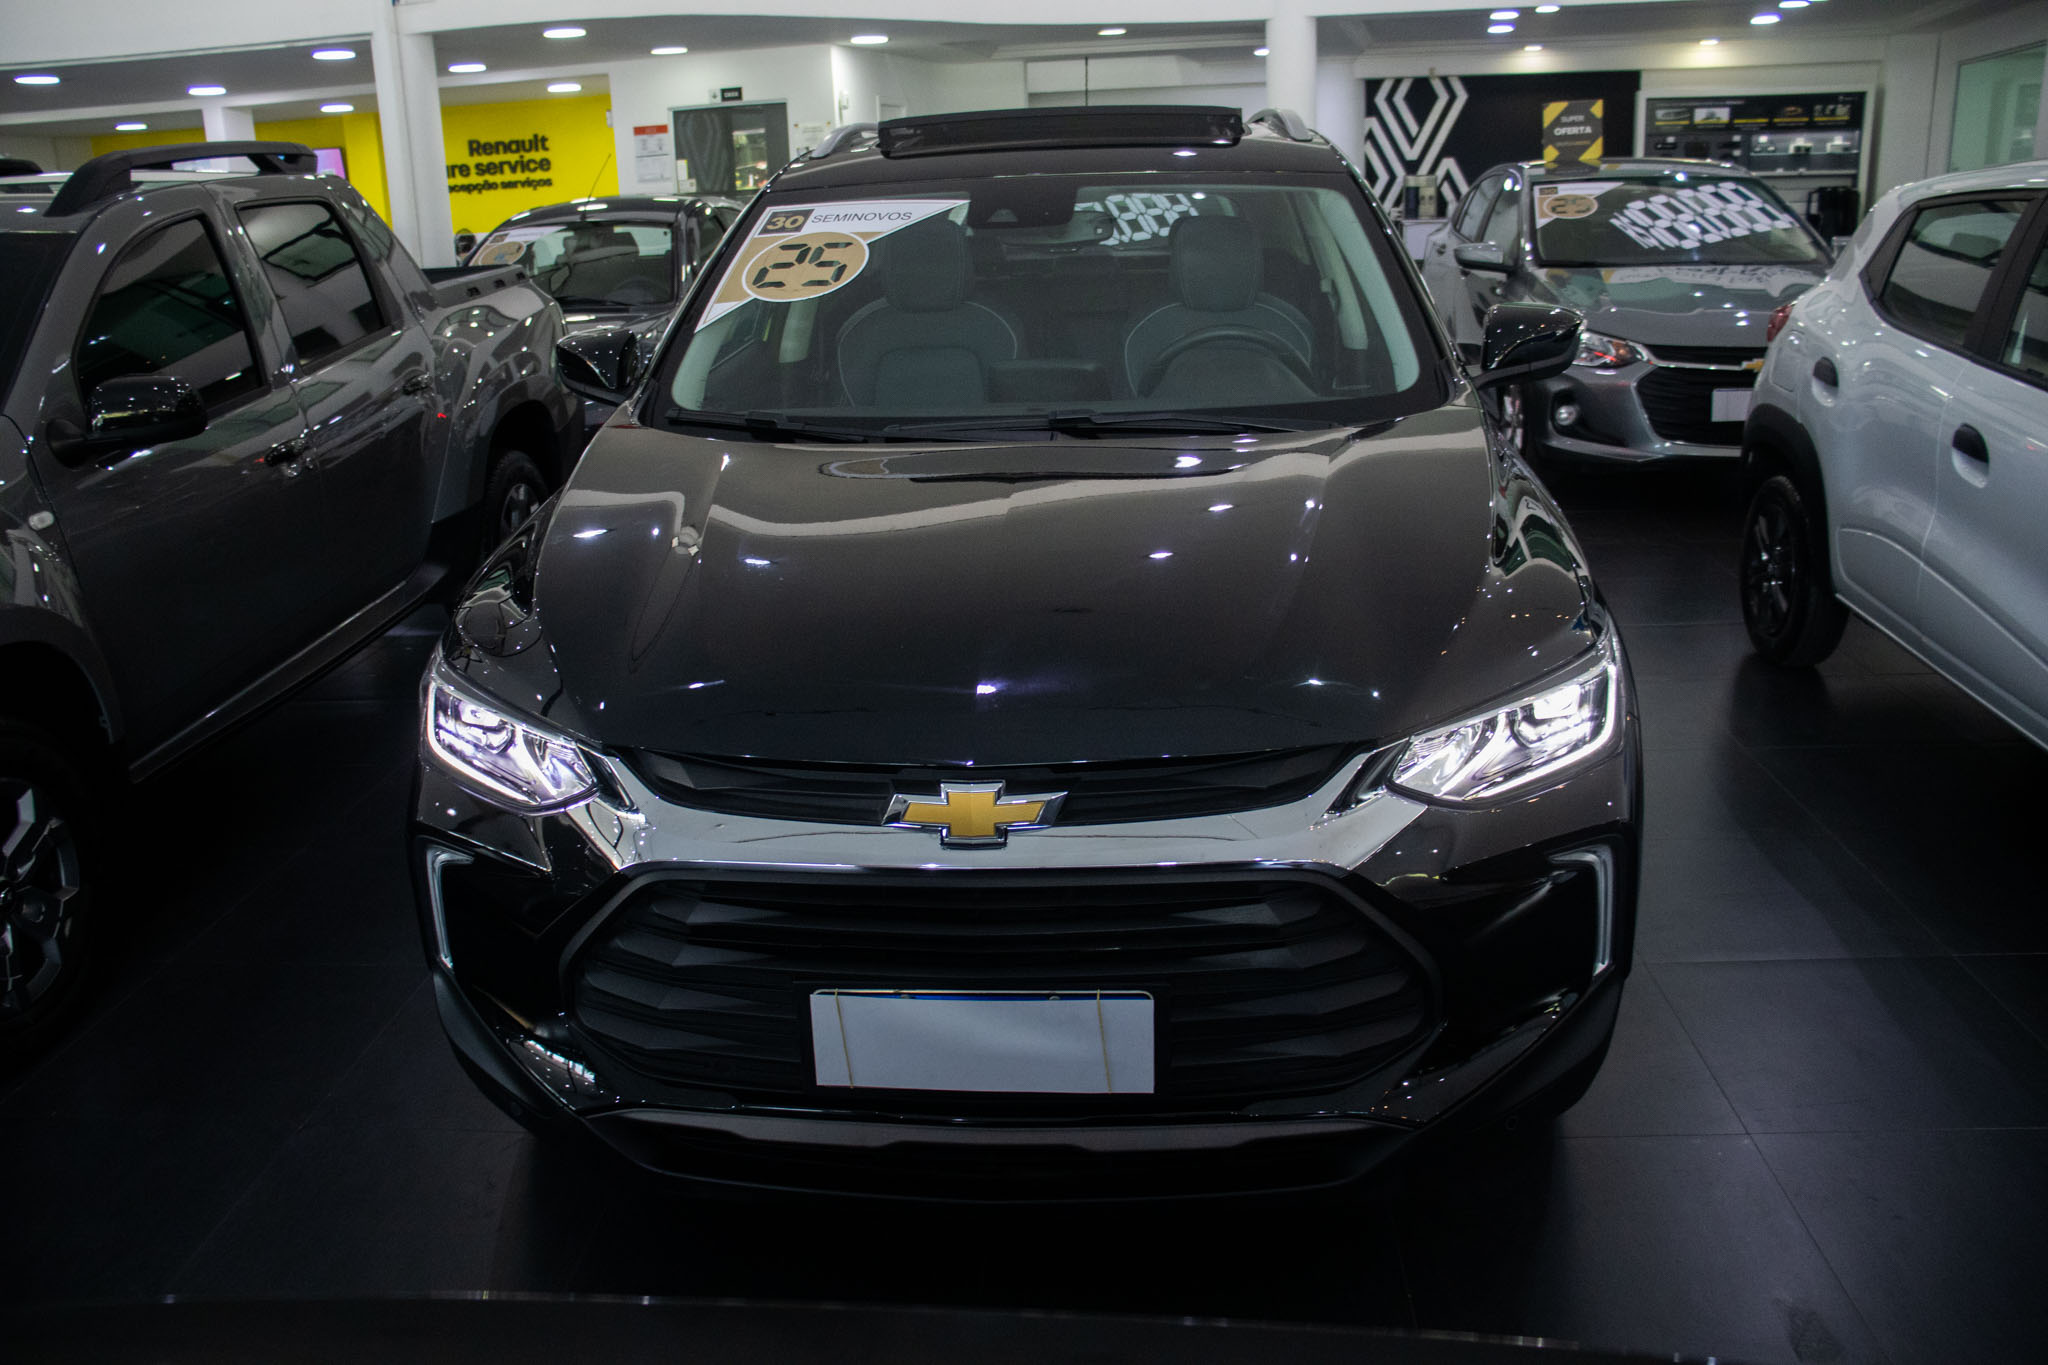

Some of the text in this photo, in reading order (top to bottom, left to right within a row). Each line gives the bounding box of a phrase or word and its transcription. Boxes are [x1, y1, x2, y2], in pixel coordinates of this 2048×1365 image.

[1553, 126, 1593, 136] OFERTA
[467, 133, 550, 157] Renault
[474, 155, 551, 176] service
[766, 211, 912, 230] 30 SEMINOVOS
[752, 242, 854, 288] 25
